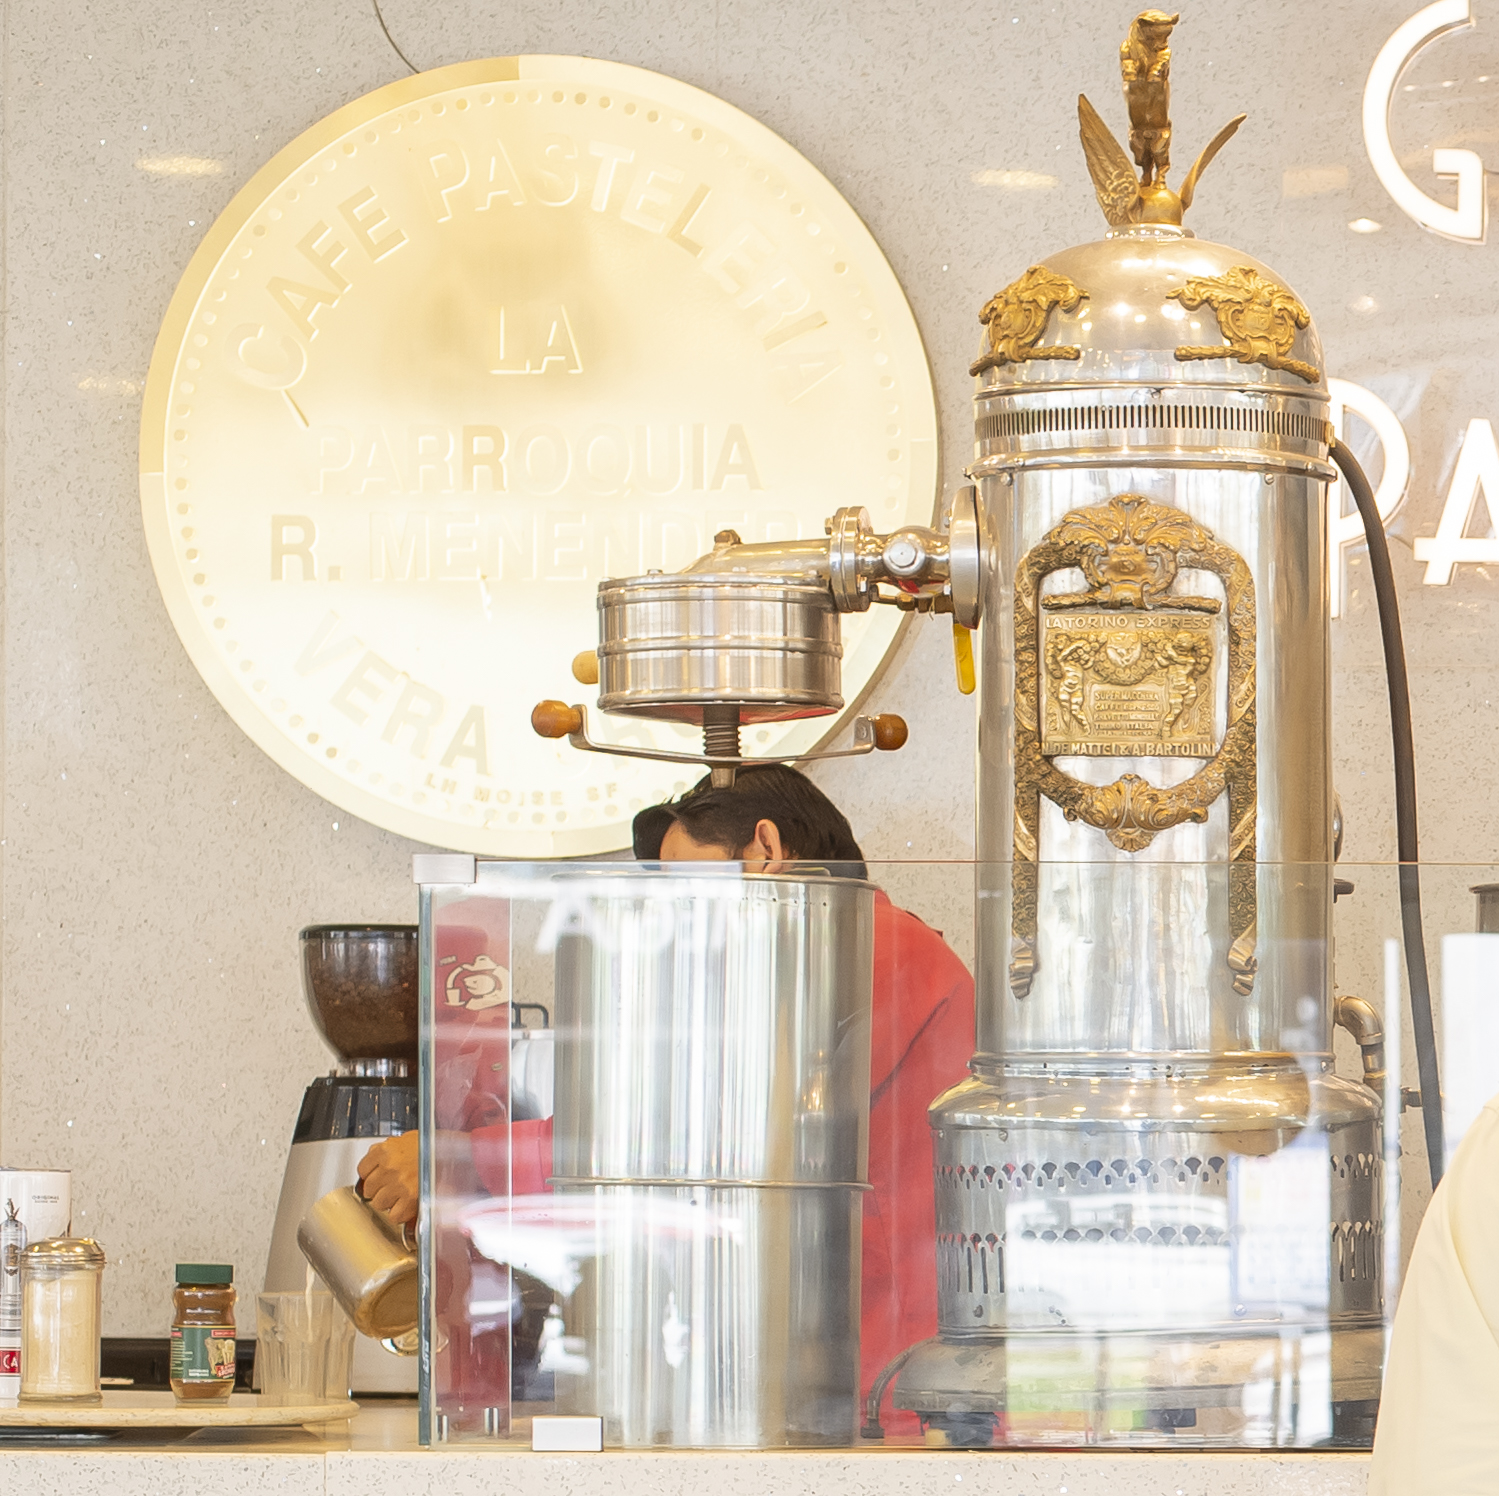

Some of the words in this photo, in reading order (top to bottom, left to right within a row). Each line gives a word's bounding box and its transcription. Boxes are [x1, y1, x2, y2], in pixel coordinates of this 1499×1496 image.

[226, 185, 409, 391] CAFE
[426, 134, 846, 404] PASTELERIA
[488, 303, 585, 376] LA
[308, 421, 767, 498] PARROQUIA
[269, 512, 346, 583] R.
[1136, 616, 1211, 630] EXPRESS
